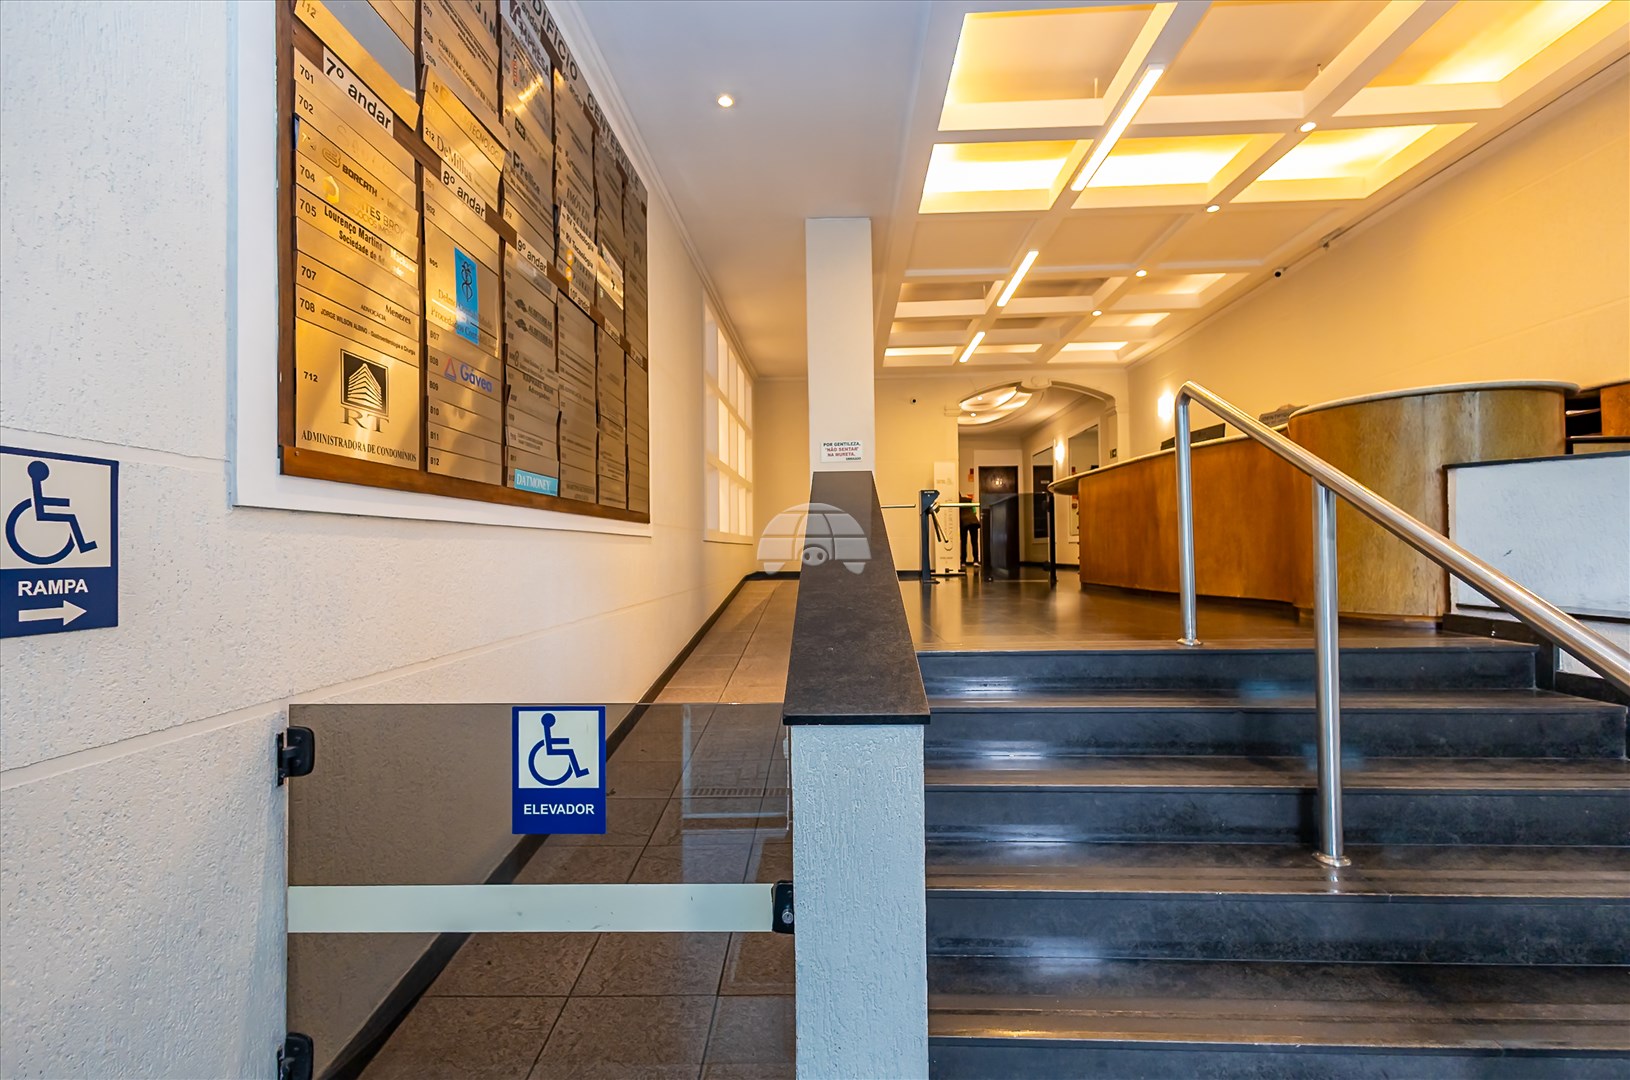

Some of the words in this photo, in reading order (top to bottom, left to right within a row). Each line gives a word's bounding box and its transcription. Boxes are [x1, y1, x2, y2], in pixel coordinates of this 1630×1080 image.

[299, 64, 315, 85] 701
[298, 94, 314, 115] 702
[348, 84, 391, 129] andar
[300, 164, 316, 183] 704
[457, 186, 485, 217] andar
[300, 198, 317, 217] 705
[324, 205, 356, 236] Lourenço
[358, 228, 383, 252] Martins
[338, 229, 369, 258] Sociedade
[527, 250, 547, 273] andar
[301, 265, 317, 281] 707
[300, 298, 315, 313] 708
[385, 305, 412, 325] Menezes
[303, 371, 318, 383] 712
[459, 362, 493, 393] Gávea
[340, 405, 390, 433] RT
[301, 429, 366, 453] ADMINISTRADORA
[367, 444, 376, 454] DE
[376, 446, 417, 462] CONDOMÍNIOS
[17, 578, 89, 597] RAMPA
[523, 803, 595, 815] ELEVADOR
